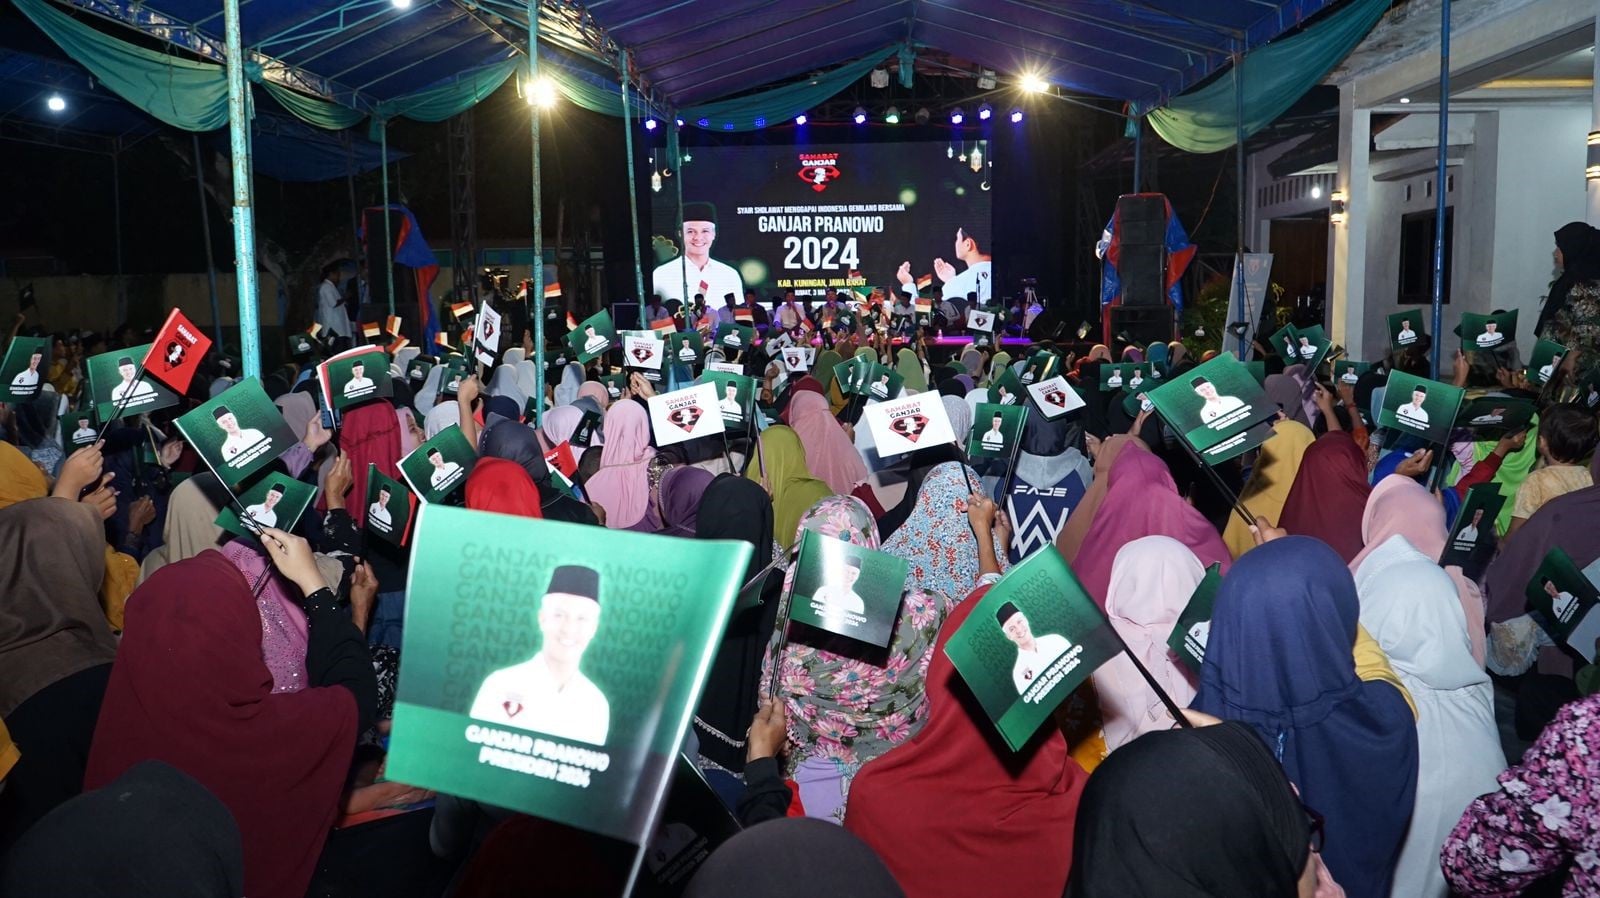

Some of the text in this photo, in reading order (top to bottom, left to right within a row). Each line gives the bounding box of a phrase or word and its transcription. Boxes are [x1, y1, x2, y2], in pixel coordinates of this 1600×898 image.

[758, 216, 884, 232] GANJAR PRANOWO
[784, 236, 860, 270] 2024
[794, 279, 827, 288] KUNINGAN,
[828, 278, 845, 286] JAWA
[665, 393, 698, 406] SAHABAT
[668, 399, 697, 410] GANJAR
[885, 402, 921, 414] SAHABAT
[890, 407, 921, 418] GANJAR
[1023, 676, 1048, 704] GANJAR
[1045, 645, 1083, 680] PRANOWO
[1033, 657, 1080, 704] PRESIDEN 2024
[465, 724, 610, 772] GANJAR PRANOWO
[478, 746, 591, 788] PRESIDEN 2024
